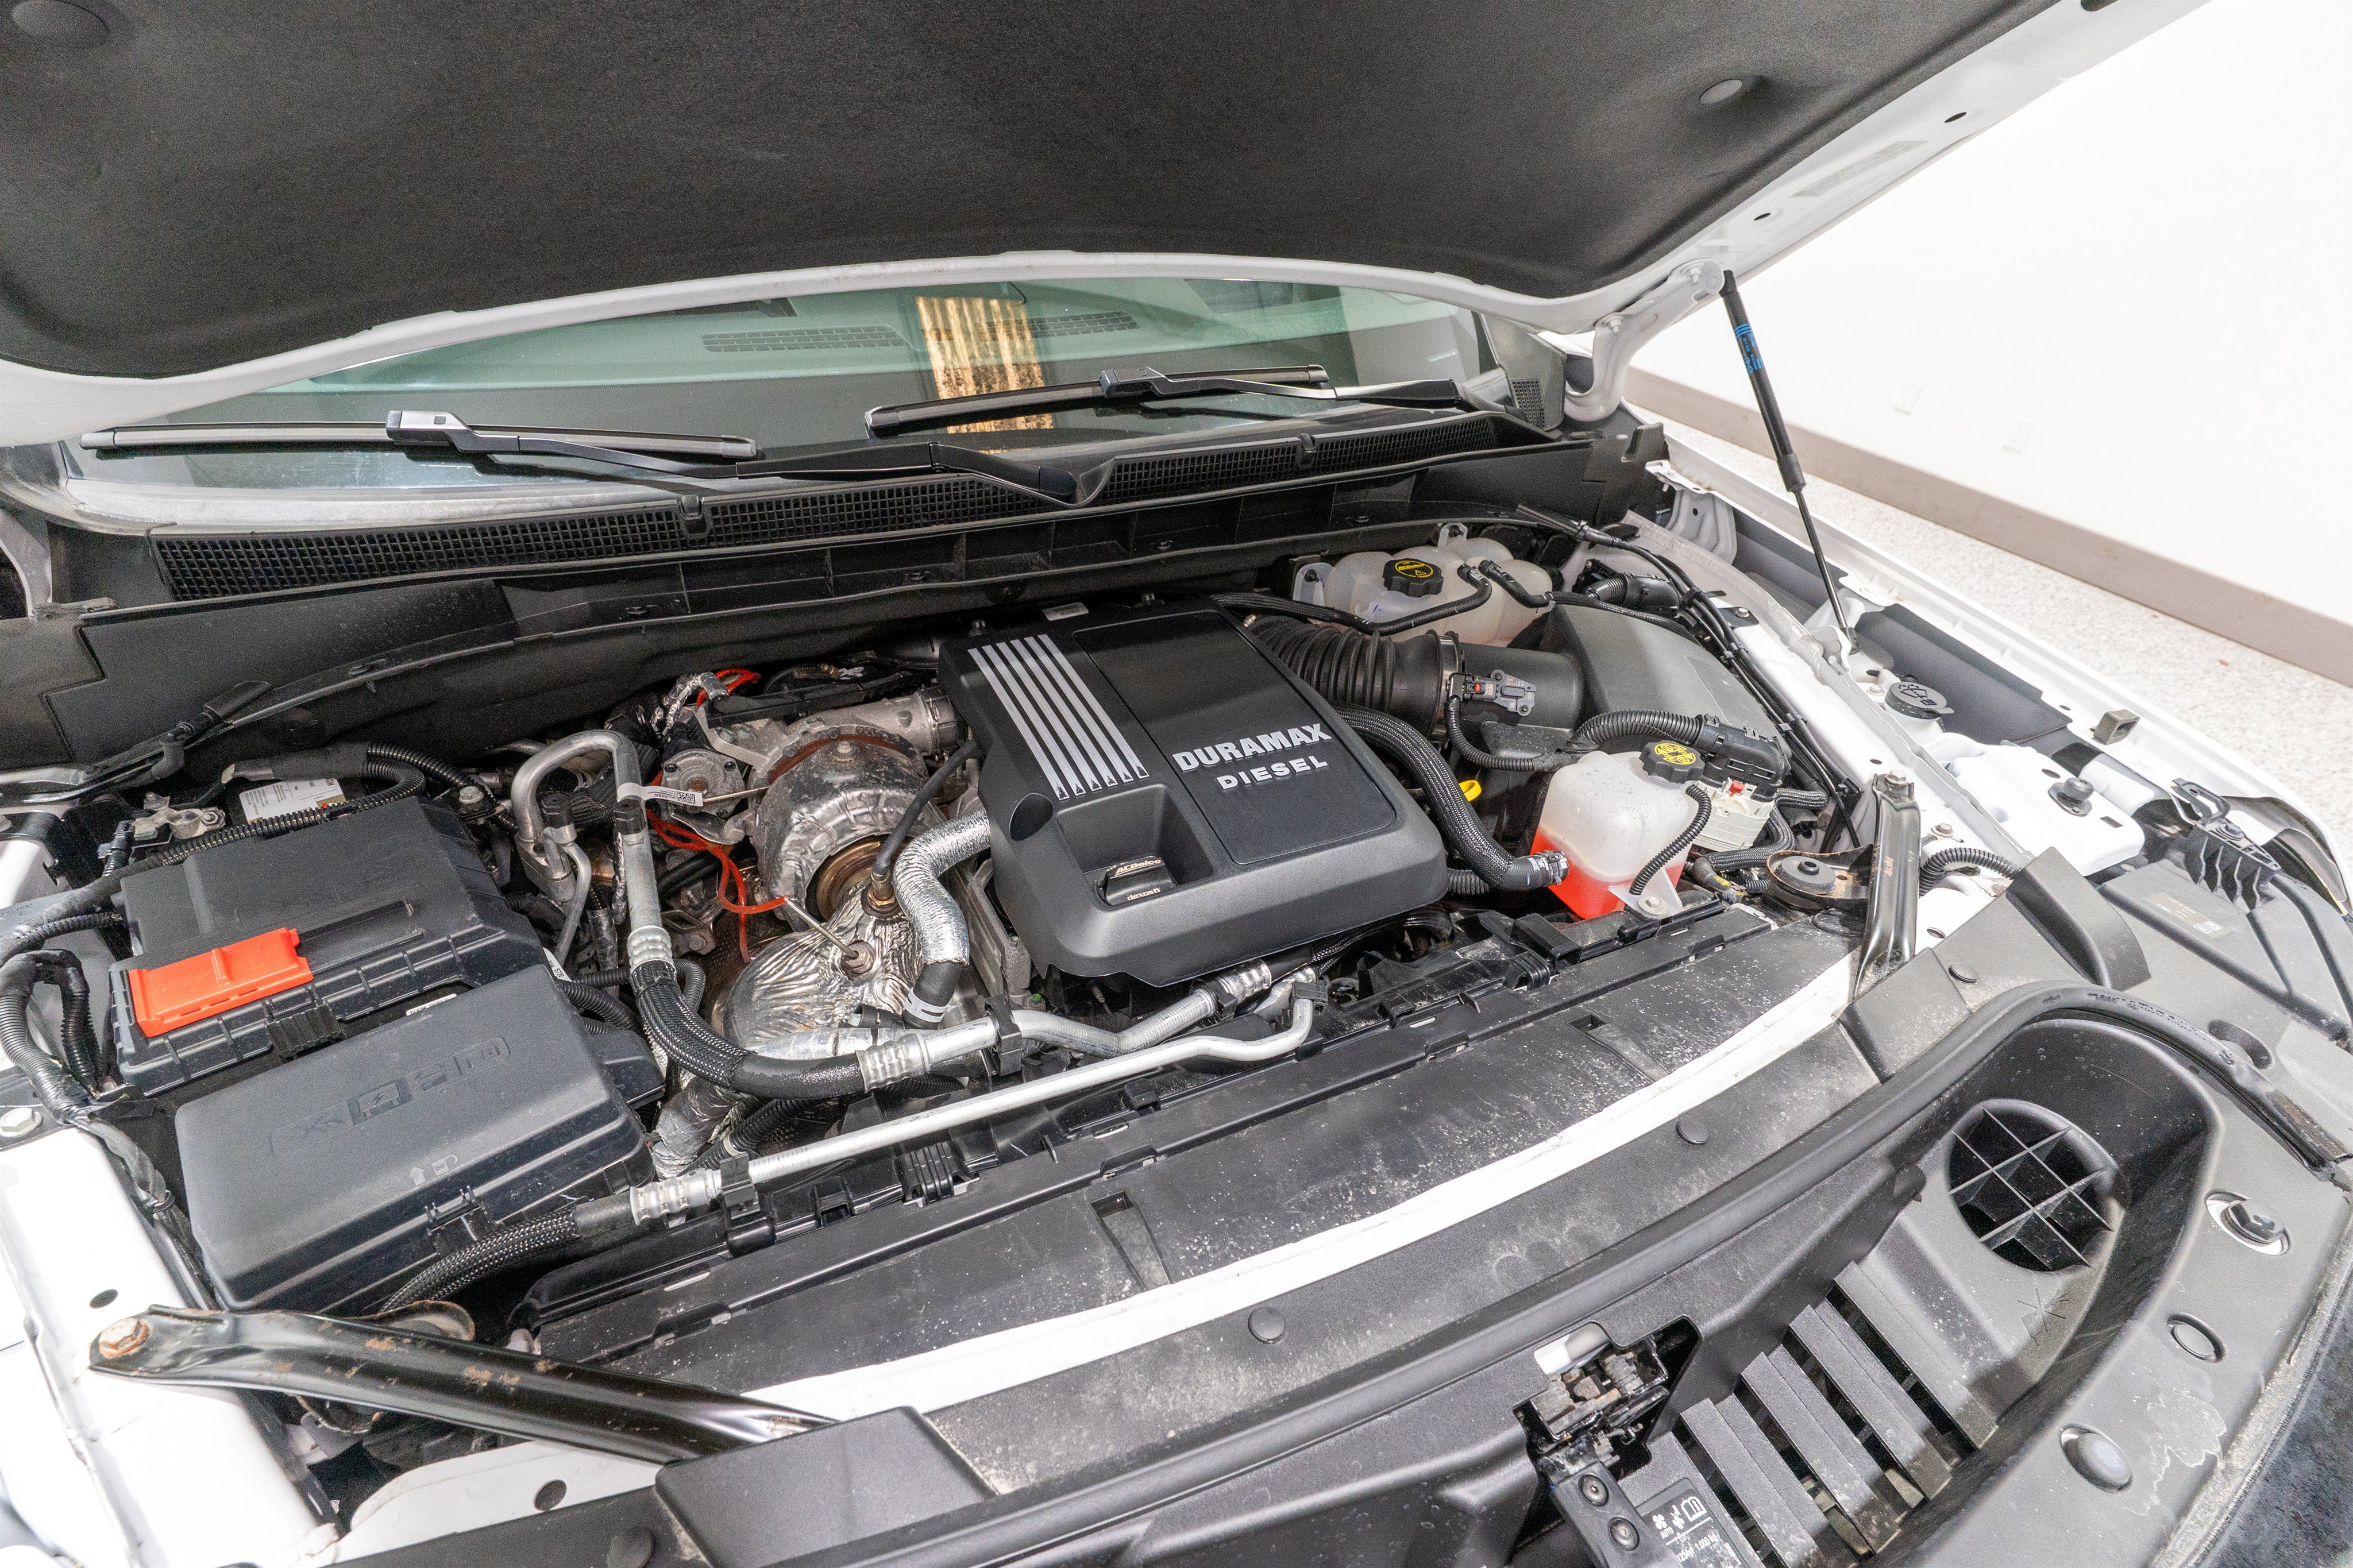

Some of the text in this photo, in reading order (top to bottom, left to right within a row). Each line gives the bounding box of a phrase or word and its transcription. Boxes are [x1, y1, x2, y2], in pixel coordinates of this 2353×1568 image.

[1172, 723, 1332, 772] DURAMAX
[1216, 755, 1328, 790] DIESEL
[1115, 859, 1162, 875] ACDelco
[1660, 1527, 1674, 1539] AUTO
